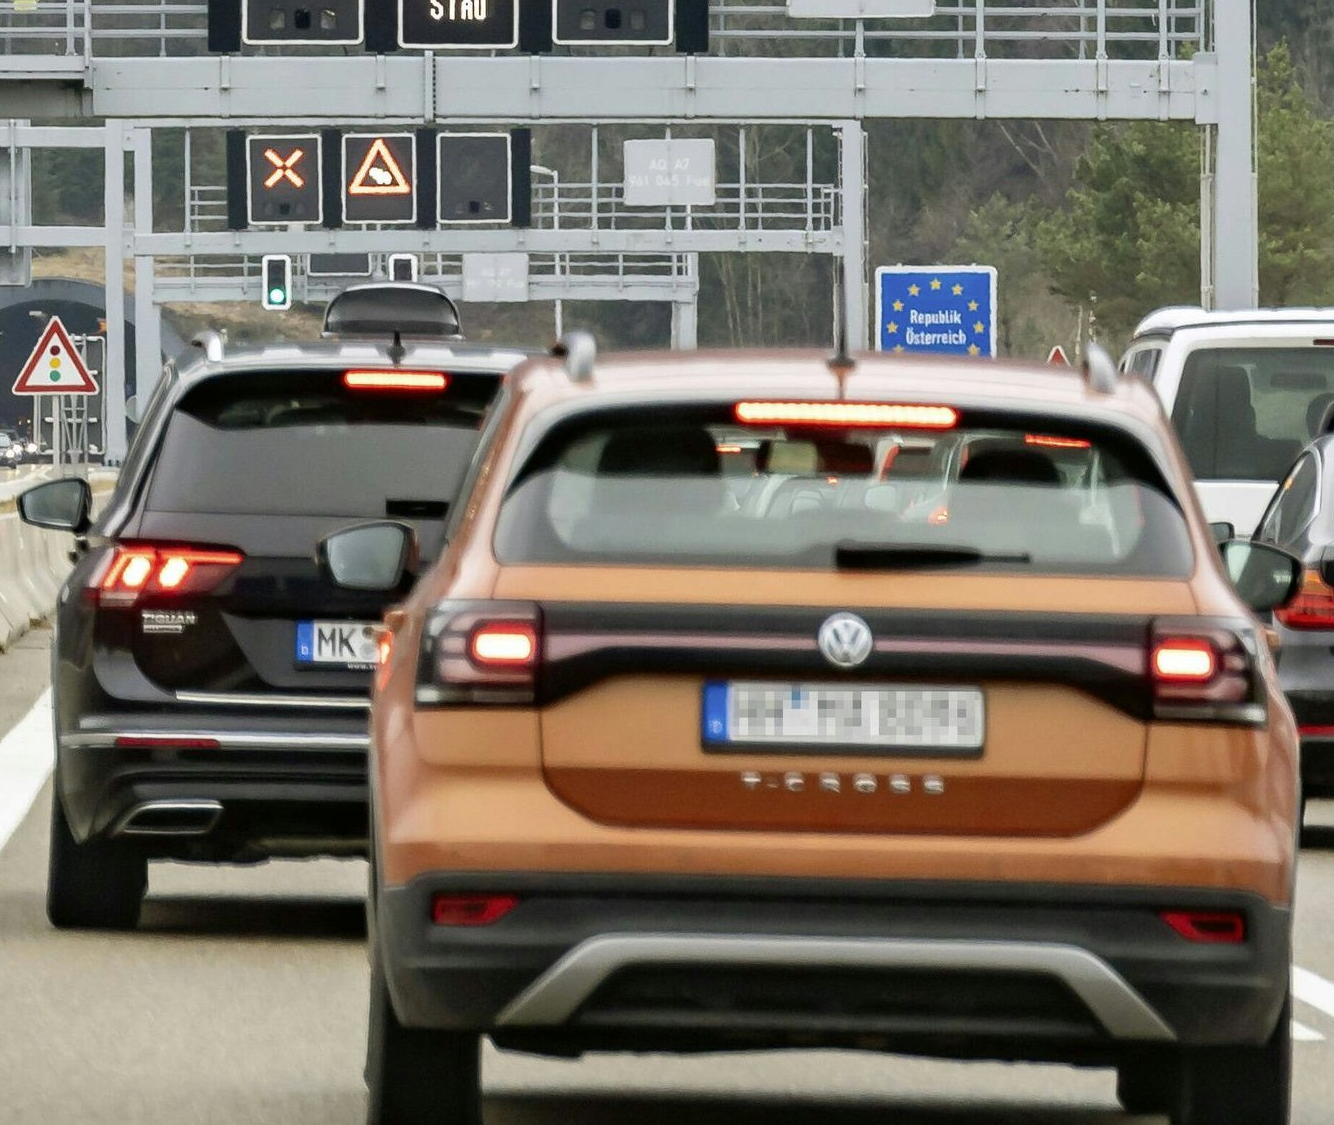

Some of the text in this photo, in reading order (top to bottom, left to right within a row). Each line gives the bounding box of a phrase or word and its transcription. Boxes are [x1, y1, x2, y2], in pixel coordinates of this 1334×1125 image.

[910, 309, 962, 327] Republik
[906, 326, 967, 345] Österreich
[318, 627, 357, 657] MK
